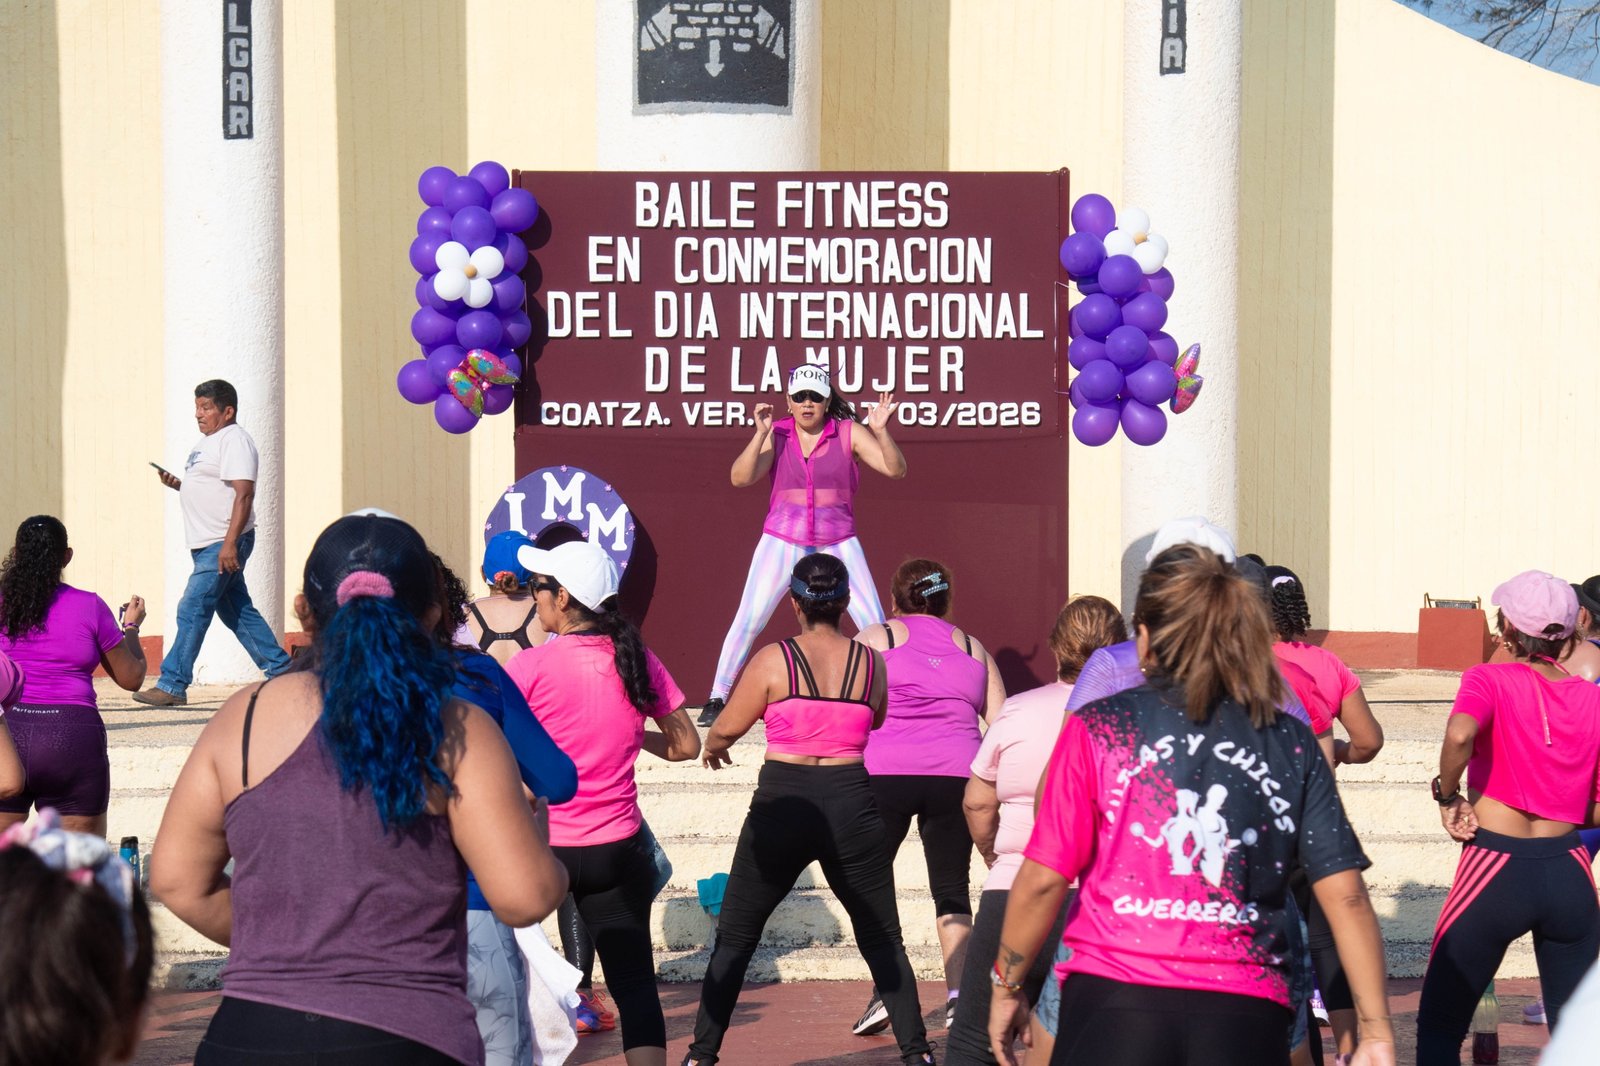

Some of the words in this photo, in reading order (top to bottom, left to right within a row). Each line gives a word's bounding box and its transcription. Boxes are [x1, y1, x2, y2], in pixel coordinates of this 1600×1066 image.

[1162, 0, 1183, 68] IA
[636, 180, 755, 228] BAILE
[777, 180, 949, 228] FITNESS
[588, 236, 641, 283] EN
[674, 237, 992, 284] CONMEMORACION
[547, 291, 633, 338] DEL
[655, 291, 719, 338] DIA
[740, 291, 1044, 338] INTERNACIONAL
[645, 346, 706, 393] DE
[731, 346, 782, 393] LA
[541, 402, 671, 427] COATZA.
[682, 402, 755, 427] VER.
[504, 471, 629, 551] IMM
[12, 706, 60, 714] Performance
[1186, 733, 1205, 756] Y
